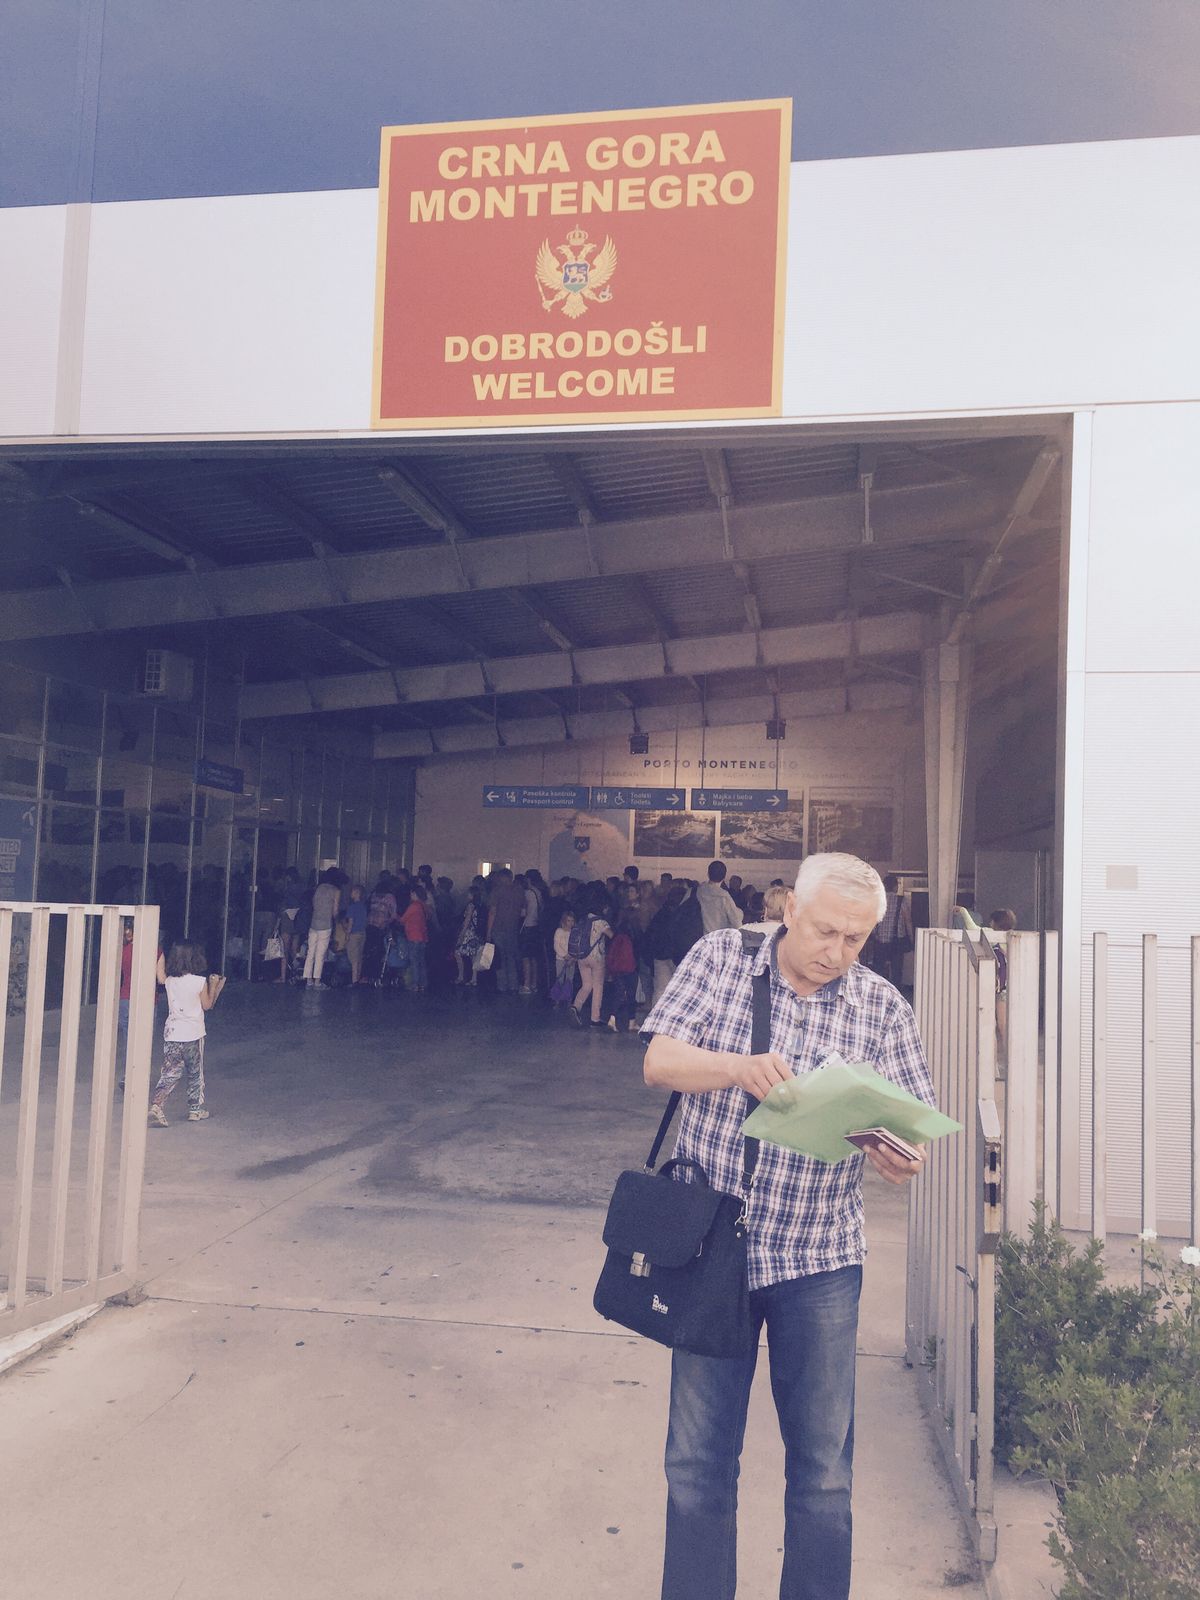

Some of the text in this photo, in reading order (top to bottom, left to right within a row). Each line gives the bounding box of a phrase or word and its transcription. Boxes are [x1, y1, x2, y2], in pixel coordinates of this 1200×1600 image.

[438, 130, 726, 180] CRNA GORA
[409, 170, 755, 223] MONTENEGRO
[444, 321, 707, 363] DOBRODOŠLI
[472, 367, 675, 401] WELCOME
